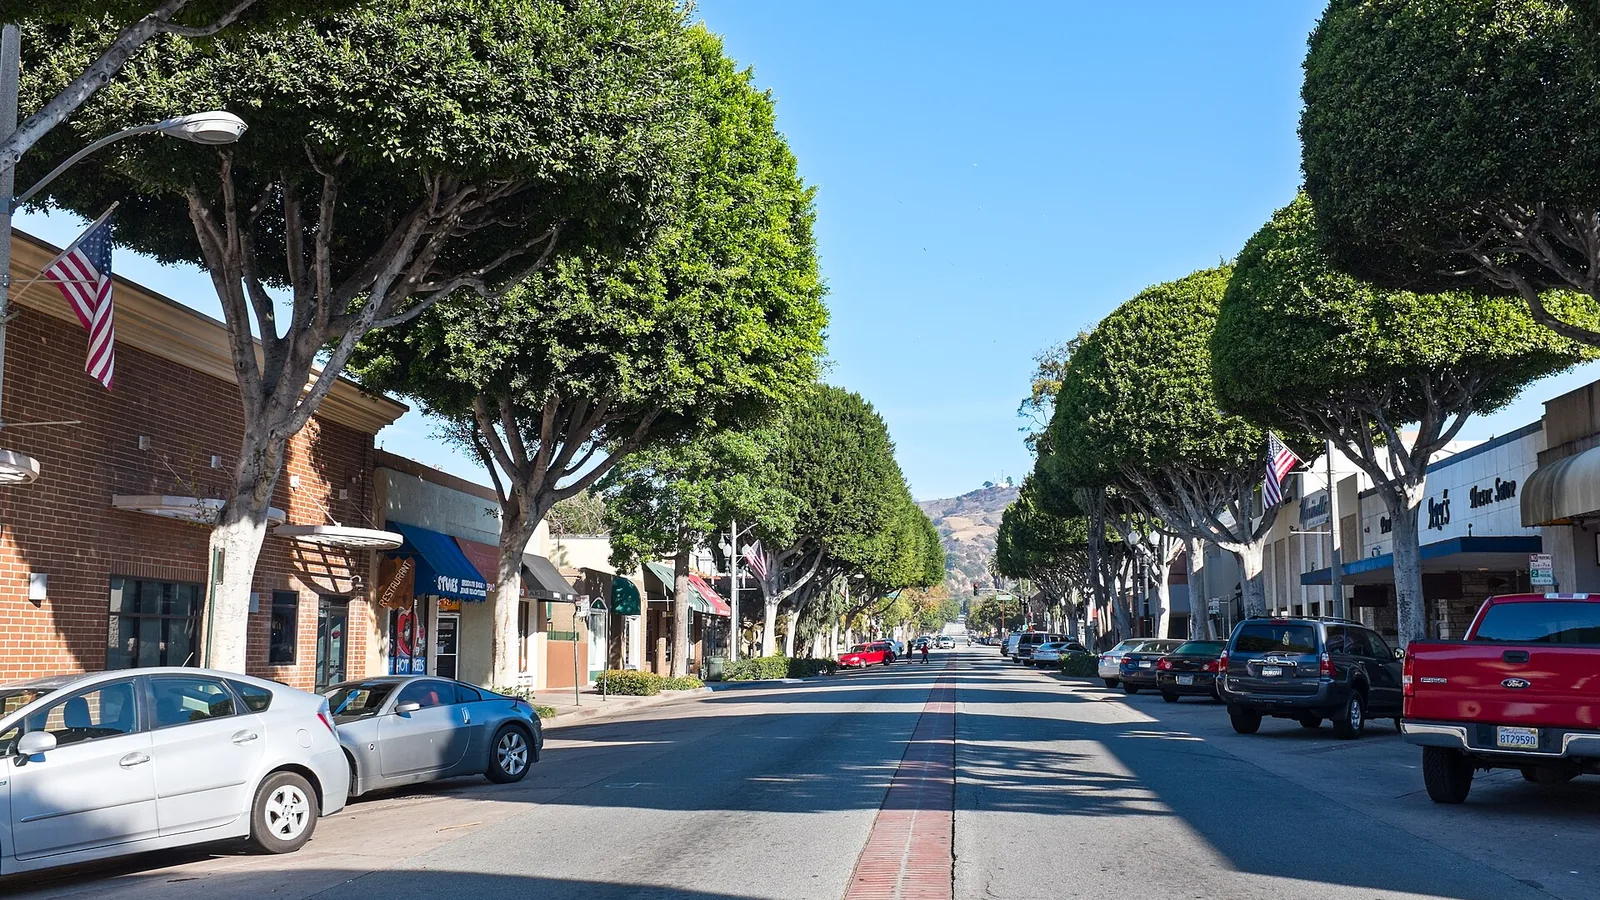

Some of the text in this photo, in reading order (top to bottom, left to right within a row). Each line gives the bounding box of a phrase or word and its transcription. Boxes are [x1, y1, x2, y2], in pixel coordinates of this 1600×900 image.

[379, 560, 411, 608] RESTAURANT
[396, 658, 409, 673] HOT
[1500, 734, 1536, 745] 8T29590
